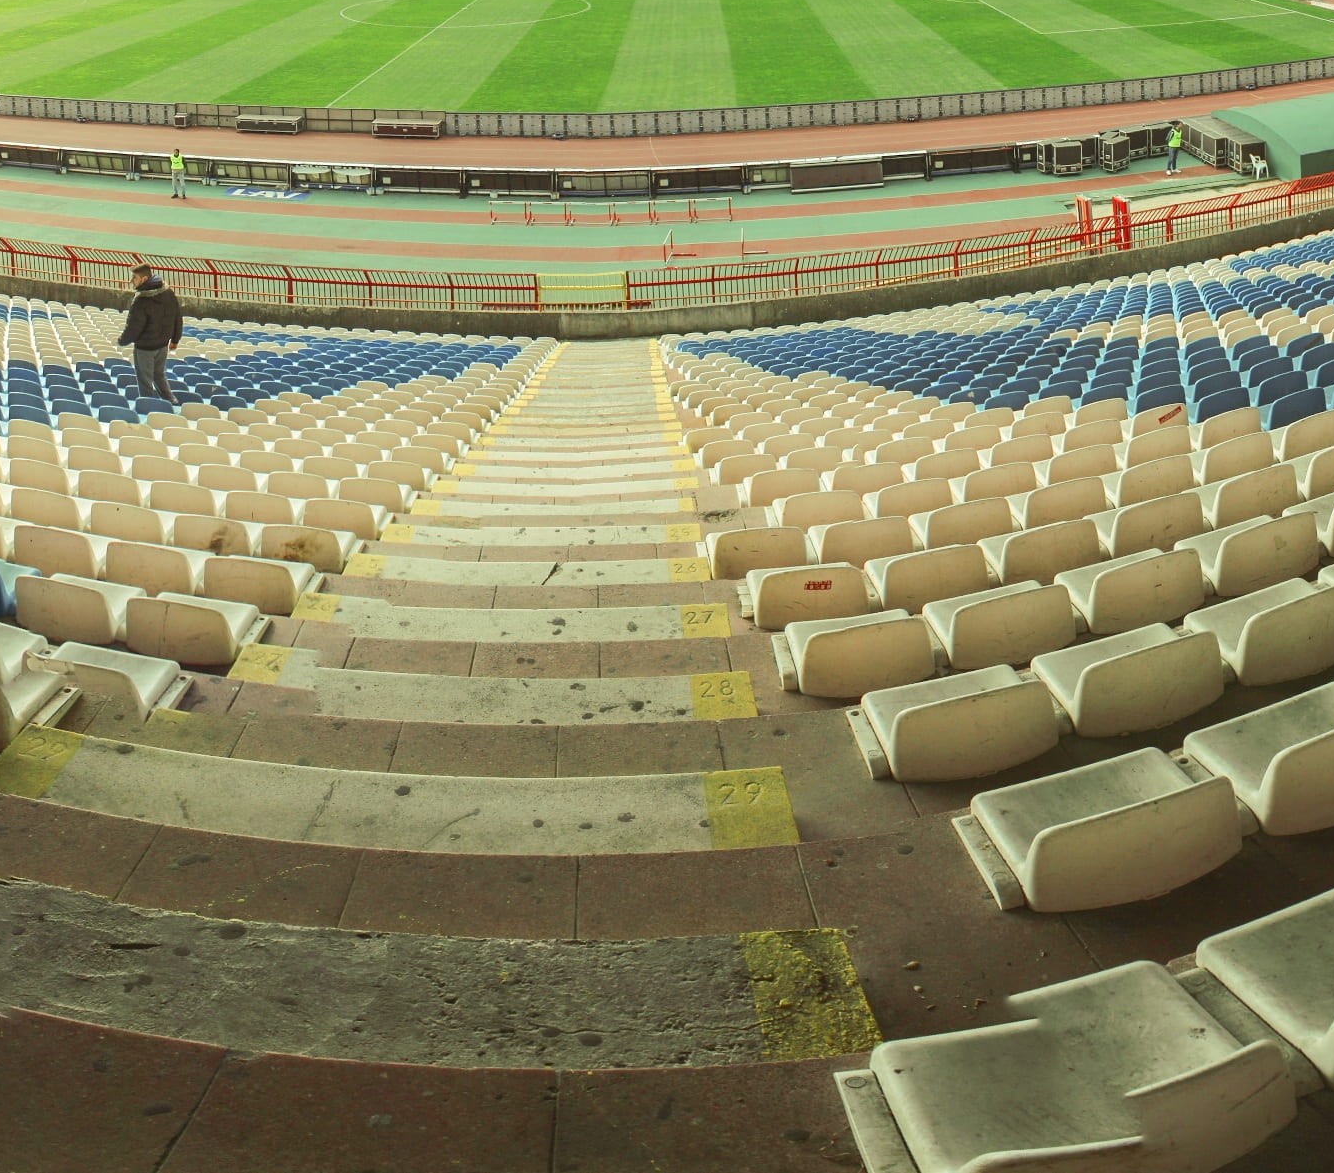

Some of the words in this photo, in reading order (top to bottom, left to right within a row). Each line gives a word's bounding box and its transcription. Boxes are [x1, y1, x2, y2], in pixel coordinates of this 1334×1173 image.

[231, 188, 302, 199] LAV
[673, 562, 698, 575] 26
[685, 609, 714, 625] 27
[699, 680, 734, 698] 28
[717, 780, 765, 806] 29
